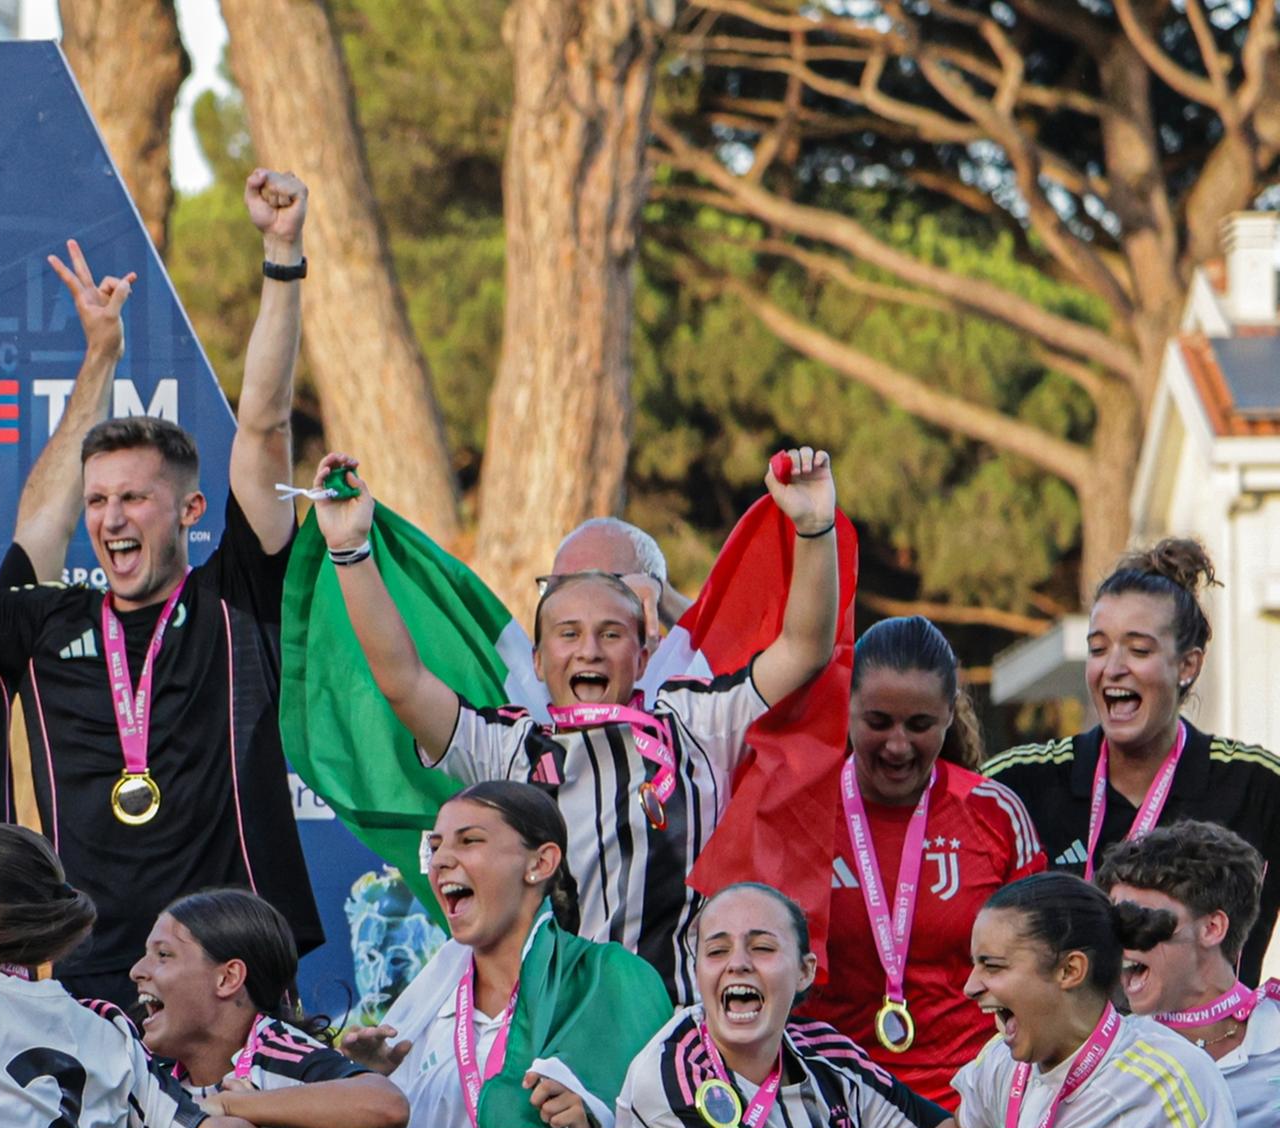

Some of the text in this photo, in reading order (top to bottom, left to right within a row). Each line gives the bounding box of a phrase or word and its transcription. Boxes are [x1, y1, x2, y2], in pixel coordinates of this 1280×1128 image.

[33, 379, 178, 437] TM
[190, 530, 211, 543] CON
[850, 814, 881, 908] FINALI NAZIONALI
[1209, 991, 1241, 1017] FINALI
[458, 1012, 470, 1066] NAZIONALI
[1074, 1051, 1096, 1078] UNDER
